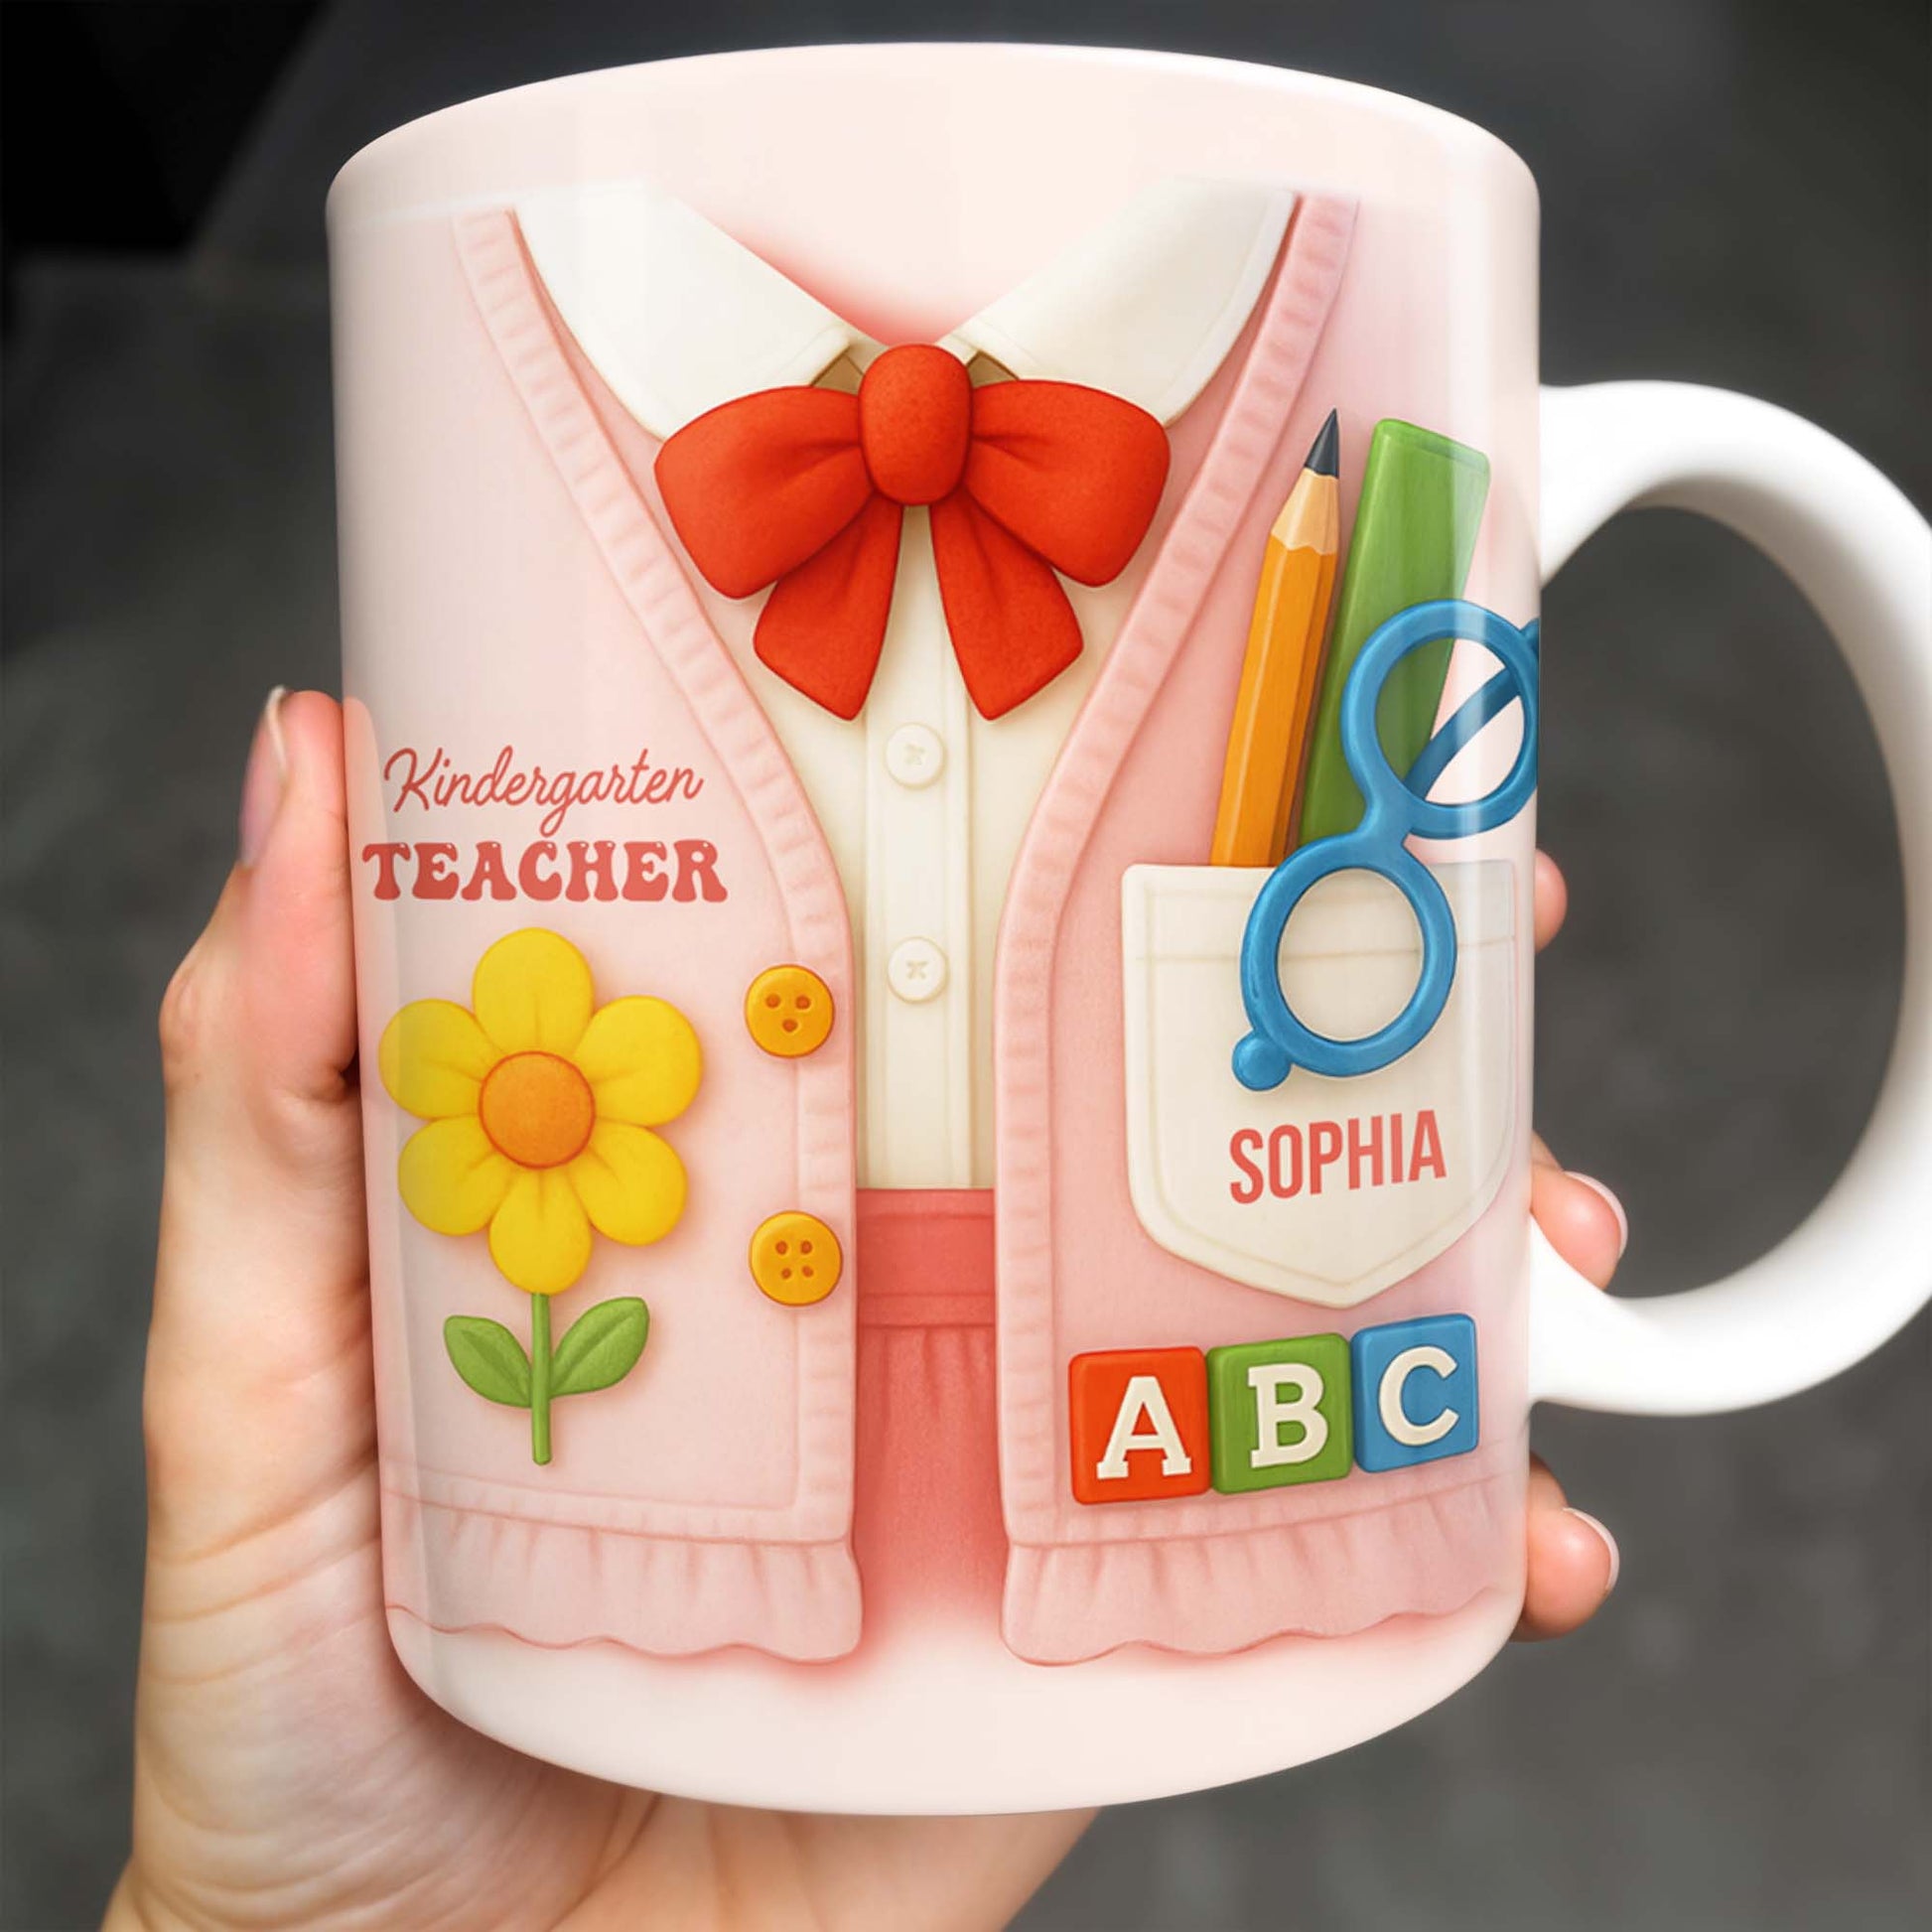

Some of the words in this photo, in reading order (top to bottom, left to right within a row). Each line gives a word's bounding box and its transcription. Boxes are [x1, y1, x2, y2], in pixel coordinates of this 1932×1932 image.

[383, 745, 704, 838] Kindergarten
[361, 839, 728, 903] TEACHER
[1229, 1109, 1448, 1205] SOPHIA
